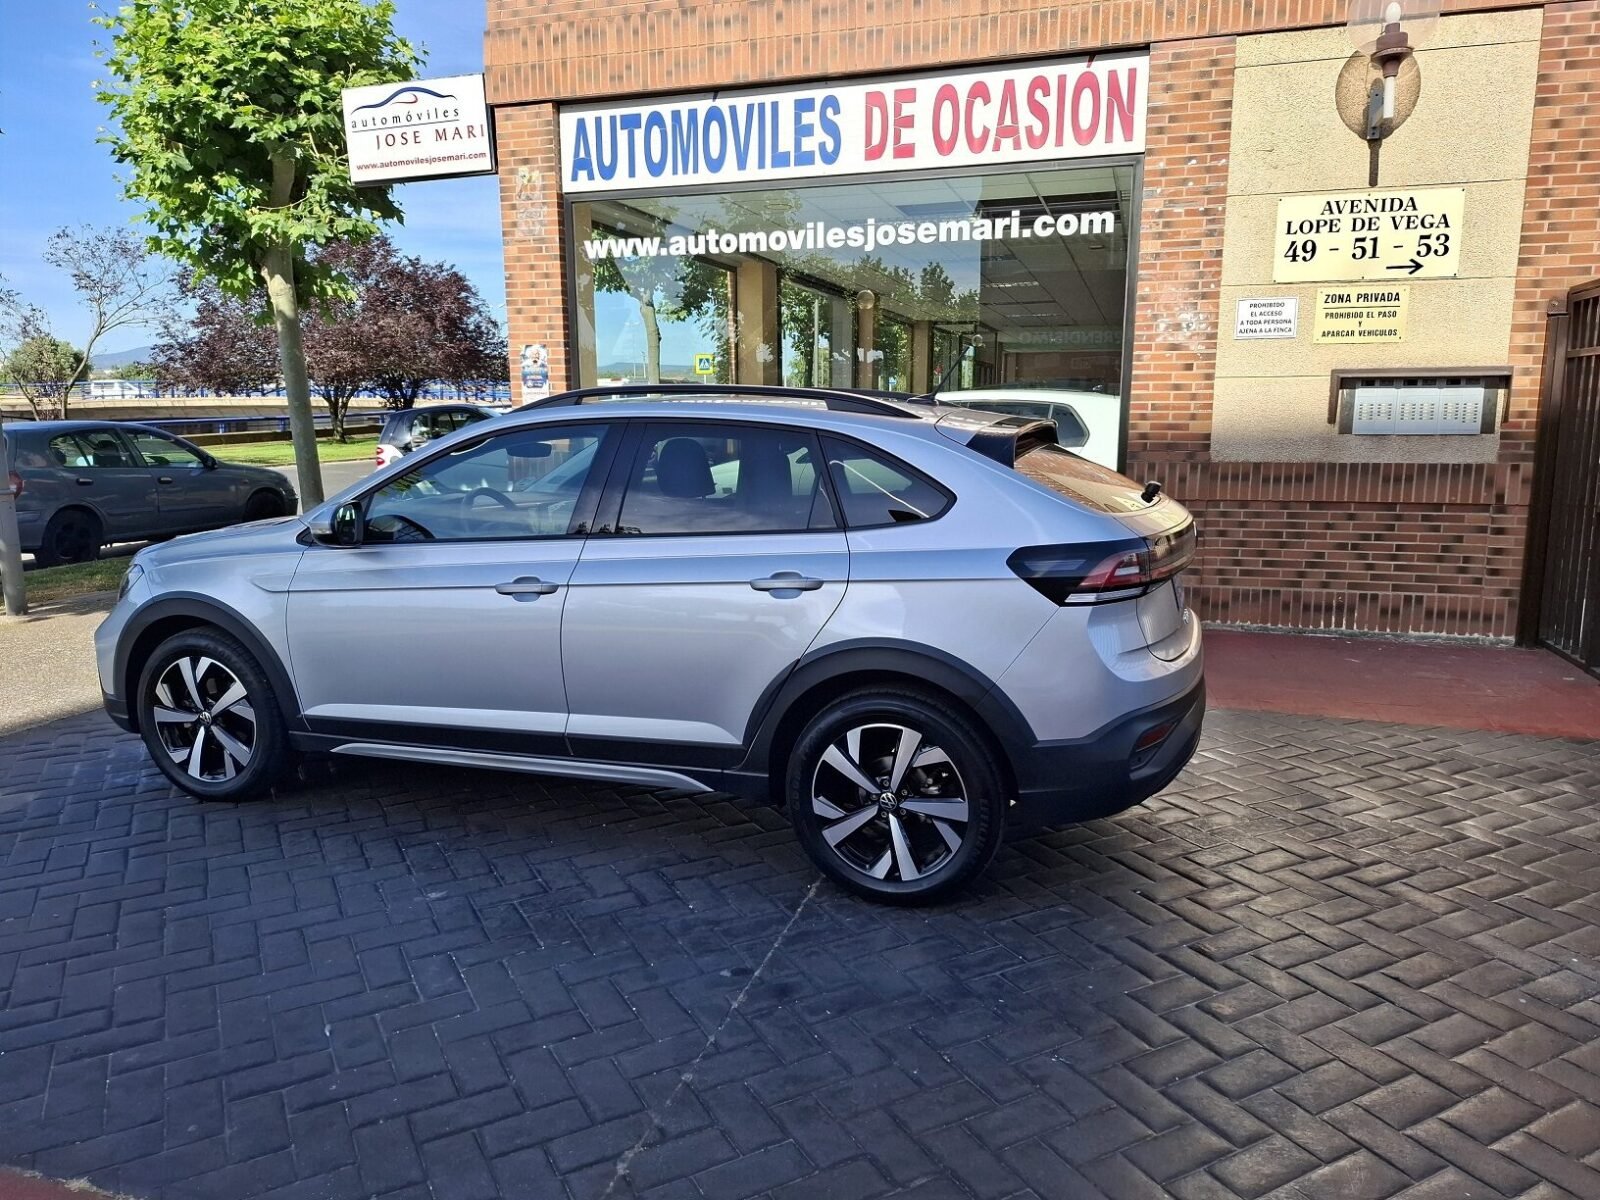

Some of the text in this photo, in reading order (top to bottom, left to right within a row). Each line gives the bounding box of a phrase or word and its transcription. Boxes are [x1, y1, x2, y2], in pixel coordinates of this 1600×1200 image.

[351, 107, 460, 129] automóviles
[570, 55, 1137, 182] AUTOMÓVILES DE OCASIÓN
[375, 123, 485, 150] JOSE MARI
[356, 151, 487, 171] www.automovilesjosemari.com
[1320, 196, 1418, 216] AVENIDA
[583, 209, 1115, 259] www.automovilesjosemari.com
[1285, 213, 1450, 235] LOPE DE VEGA
[1283, 239, 1317, 263] 49
[1351, 236, 1380, 260] 51
[1416, 233, 1450, 258] 53
[1324, 292, 1400, 304] ZONA PRIVADA
[1324, 310, 1397, 320] PROHIBIDO EL PASO
[1321, 328, 1398, 338] APARCAR VEHICULOS
